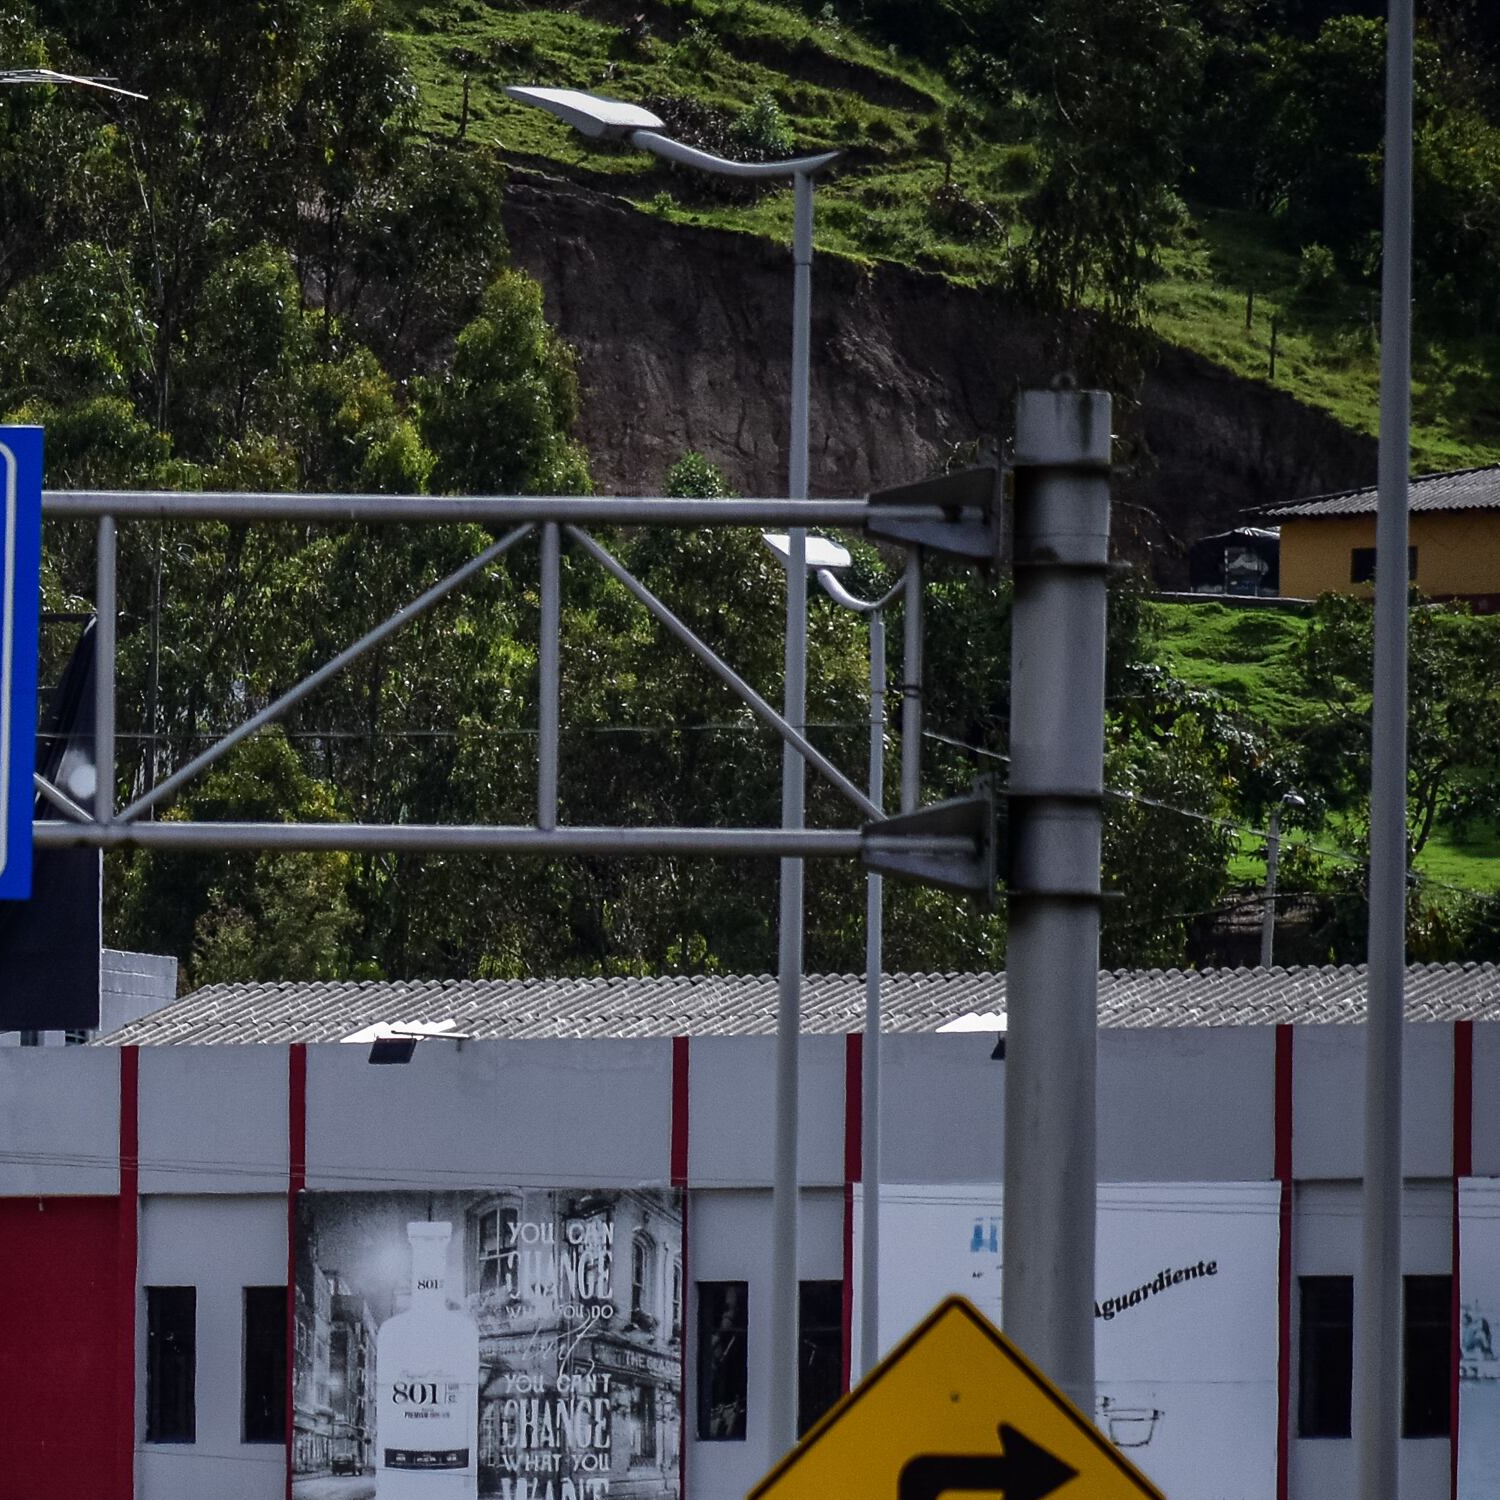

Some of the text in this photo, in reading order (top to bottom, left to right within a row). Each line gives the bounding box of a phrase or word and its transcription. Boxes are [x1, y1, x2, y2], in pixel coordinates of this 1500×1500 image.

[508, 1222, 555, 1245] YOU
[591, 1304, 614, 1319] DO
[392, 1381, 439, 1406] 801
[504, 1372, 612, 1394] YOU CAN'T
[503, 1398, 612, 1449] CHANGE
[502, 1453, 611, 1473] WHAT YOU
